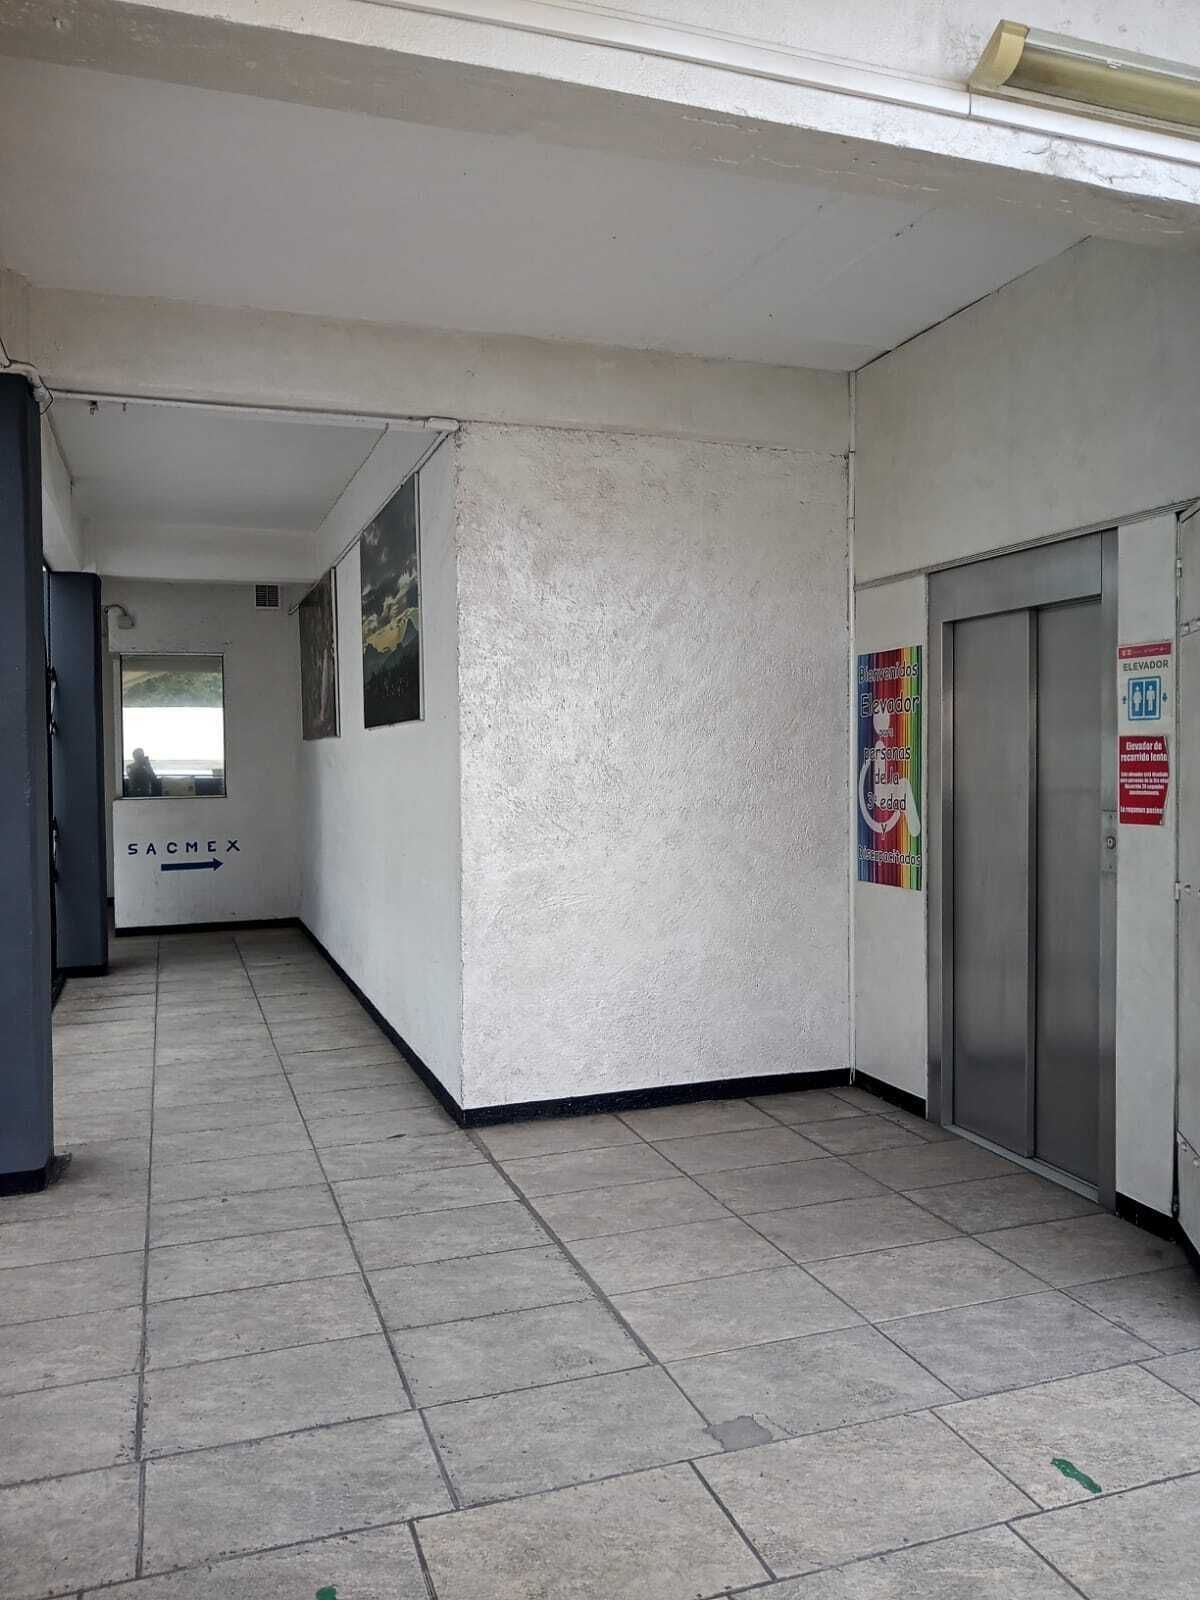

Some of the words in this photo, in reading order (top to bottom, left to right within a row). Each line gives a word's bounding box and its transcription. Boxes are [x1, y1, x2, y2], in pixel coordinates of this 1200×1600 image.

[858, 662, 919, 681] Bienvenidos
[1122, 660, 1169, 671] ELEVADOR
[860, 691, 920, 717] Elevador
[1126, 742, 1153, 750] Elevador
[1153, 742, 1163, 750] de
[864, 746, 911, 766] personas
[1121, 752, 1150, 762] recorrido
[1150, 752, 1168, 762] lento
[874, 767, 886, 785] de
[880, 792, 907, 810] edad
[128, 840, 240, 855] SACMEX
